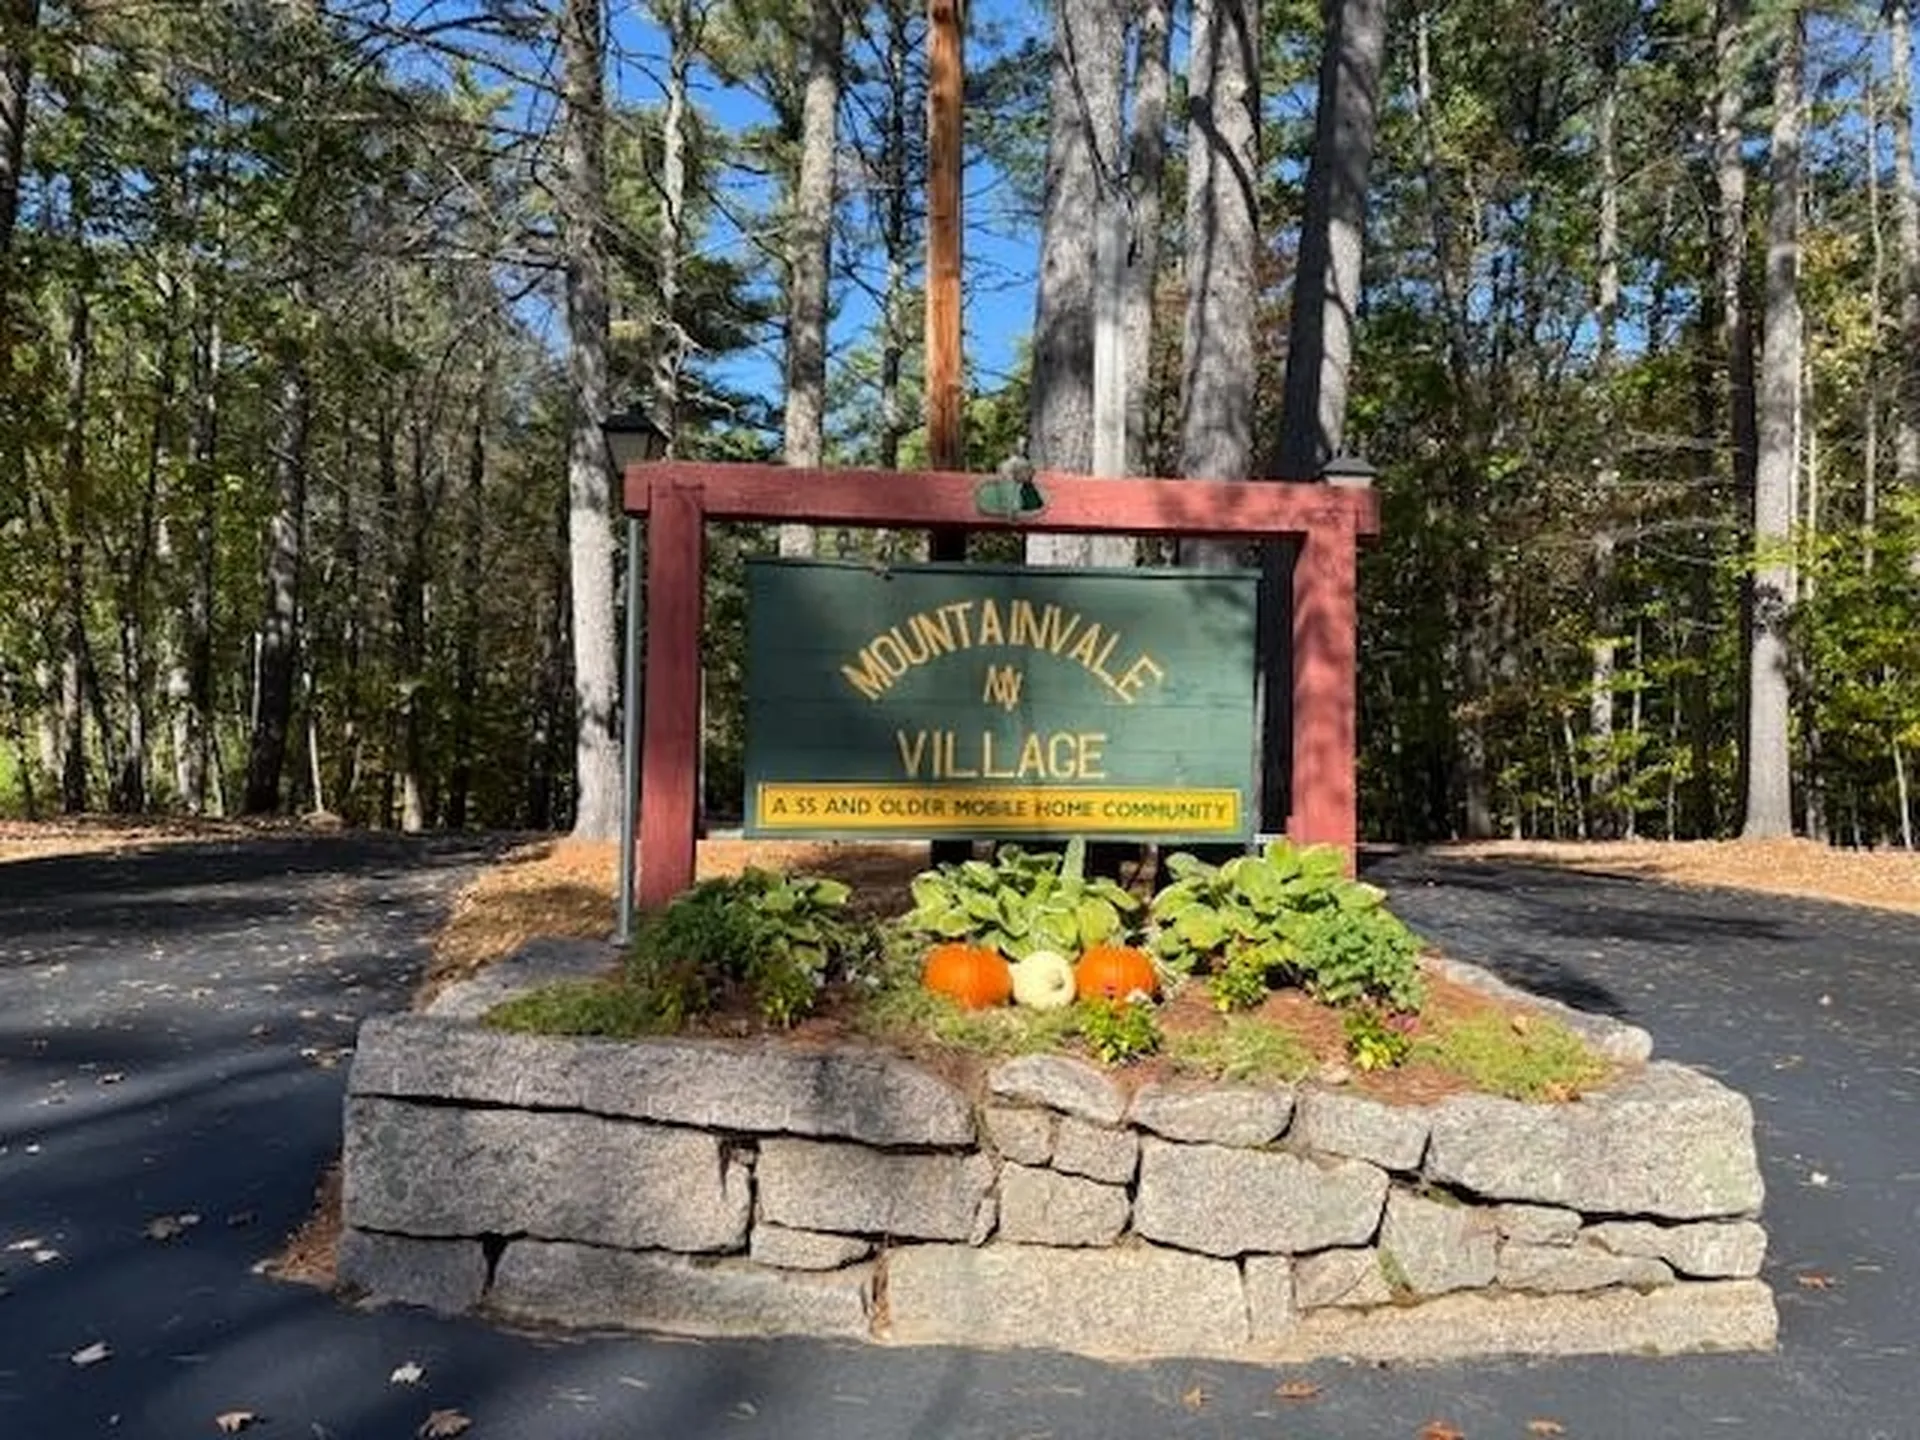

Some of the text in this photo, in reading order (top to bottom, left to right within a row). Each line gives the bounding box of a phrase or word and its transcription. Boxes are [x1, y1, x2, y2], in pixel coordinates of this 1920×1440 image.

[841, 598, 1164, 704] MOUNTAINVALE
[897, 729, 1107, 779] VILLAGE
[771, 797, 787, 814] A
[823, 798, 872, 816] AND
[878, 799, 944, 817] OLDER
[953, 799, 1027, 818] MOBILE
[1034, 801, 1095, 818] HOME
[1102, 801, 1228, 820] COMMUNITY
